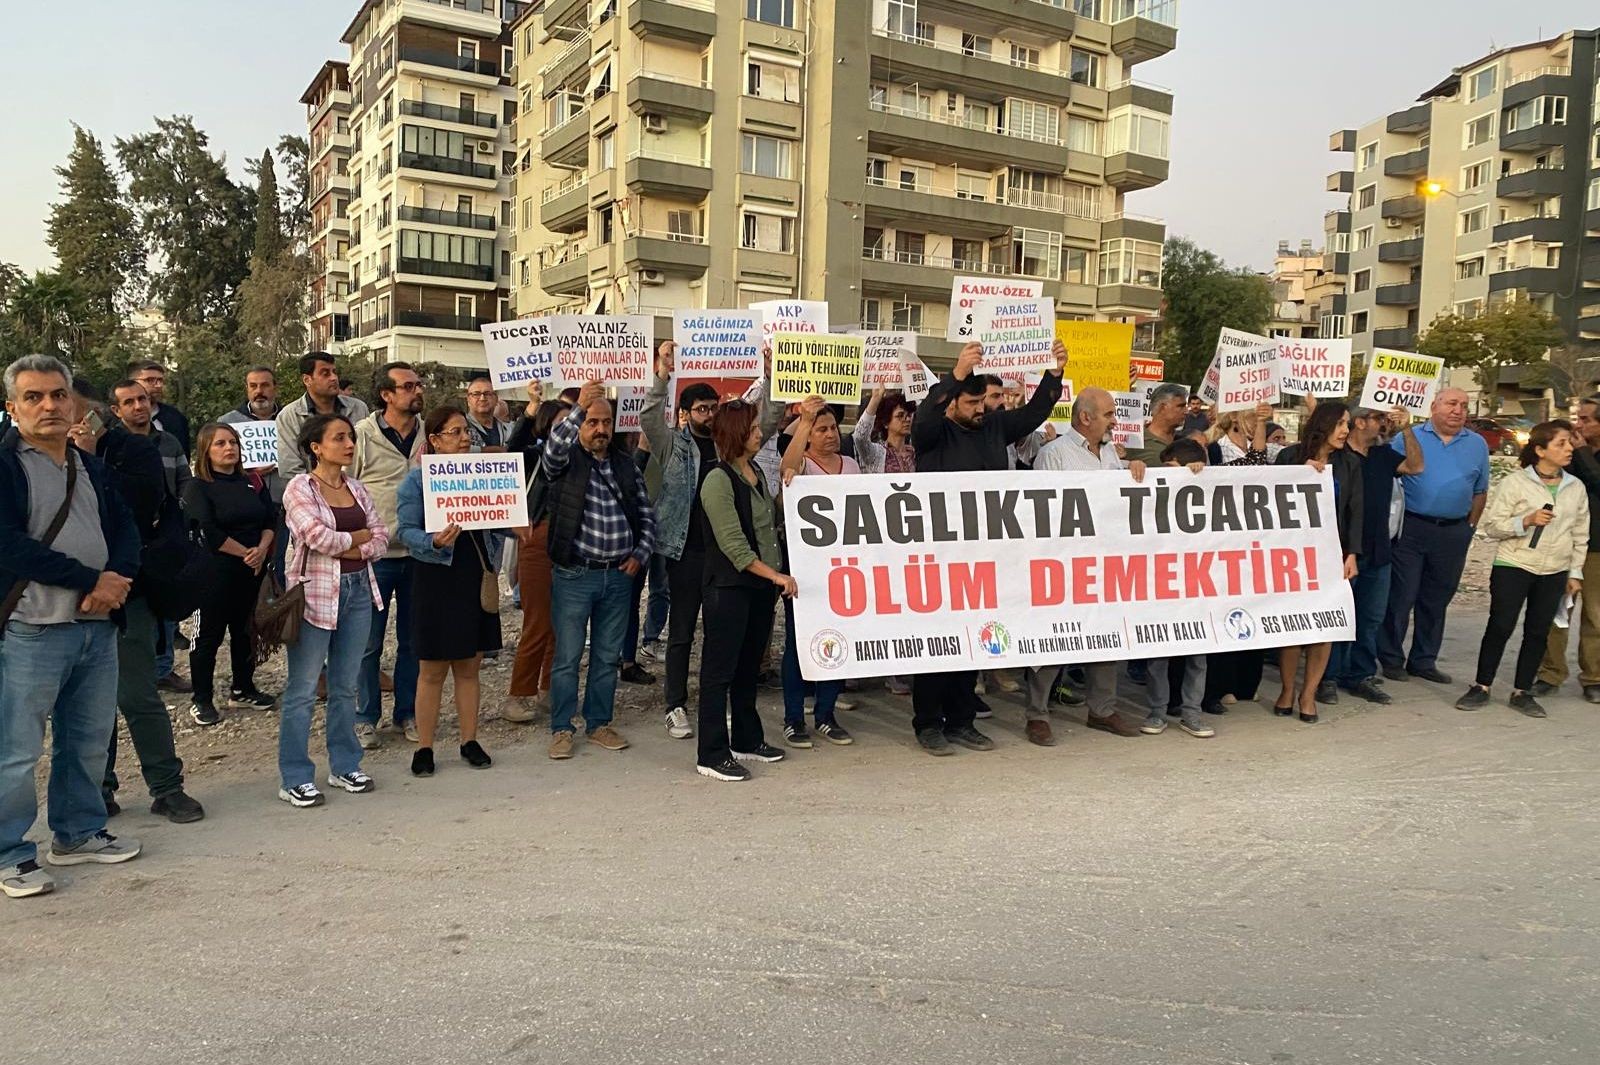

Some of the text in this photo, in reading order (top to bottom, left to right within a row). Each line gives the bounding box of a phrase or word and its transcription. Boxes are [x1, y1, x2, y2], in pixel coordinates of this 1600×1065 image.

[961, 284, 1033, 298] KAMU-ÖZEL
[776, 305, 802, 317] AKP
[995, 304, 1038, 316] PARASIZ
[578, 322, 628, 334] YALNIZ
[683, 316, 753, 329] SAĞLIĞIMIZA
[991, 315, 1042, 329] NİTELİKLİ
[490, 324, 549, 340] TÜCCAR
[691, 333, 746, 342] CANIMIZA
[980, 328, 1051, 343] ULAŞILABİLİR
[557, 332, 648, 349] YAPANLAR DEĞİL
[865, 336, 904, 346] ASTALAR
[681, 347, 757, 356] KASTEDENLER
[778, 338, 802, 355] KÖTÜ
[805, 340, 860, 359] YÖNETİMDEN
[981, 341, 1050, 355] VE ANADİLDE
[1279, 343, 1328, 361] SAĞLIK
[558, 348, 647, 364] GÖZ YUMANLAR DA
[978, 354, 1052, 368] SAĞLIK HAKKI!
[1226, 352, 1256, 368] BAKAN
[1377, 356, 1385, 368] 5
[681, 360, 758, 370] YARGILANSIN!
[777, 359, 860, 377] DAHA TEHLİKELİ
[865, 362, 876, 371] LIK
[1292, 363, 1345, 378] HAKTIR
[499, 366, 553, 383] EMEKÇİS
[561, 367, 646, 381] YARGILANSIN!
[863, 374, 871, 383] LE
[778, 376, 856, 396] VİRÜS YOKTUR!
[909, 383, 929, 394] TEDA
[1283, 376, 1344, 392] SATILAMAZ!
[1377, 376, 1428, 395] SAĞLIK
[1374, 390, 1424, 409] OLMAZ!
[619, 415, 640, 427] BAKA
[1113, 423, 1141, 432] STANELER
[241, 452, 278, 463] OLMA
[429, 459, 518, 475] SAĞLIK SİSTEMİ
[430, 475, 520, 492] İNSANLARI DEĞİL
[436, 494, 516, 508] PATRONLARI
[447, 509, 509, 523] KORUYOR!
[797, 477, 1323, 547] SAĞLIKTA TİCARET
[828, 541, 1320, 617] ÖLÜM DEMEKTİR!
[1052, 621, 1081, 634] HATAY
[1261, 607, 1348, 634] SES HATAY ŞUBESİ
[1135, 621, 1207, 644] HATAY HALKI
[855, 639, 890, 662] HATAY
[892, 635, 924, 659] TABİP
[928, 636, 961, 657] ODASI
[1018, 637, 1036, 655] AİLE
[1039, 633, 1084, 653] HEKİMLERİ
[1086, 631, 1122, 649] DERNEĞİ
